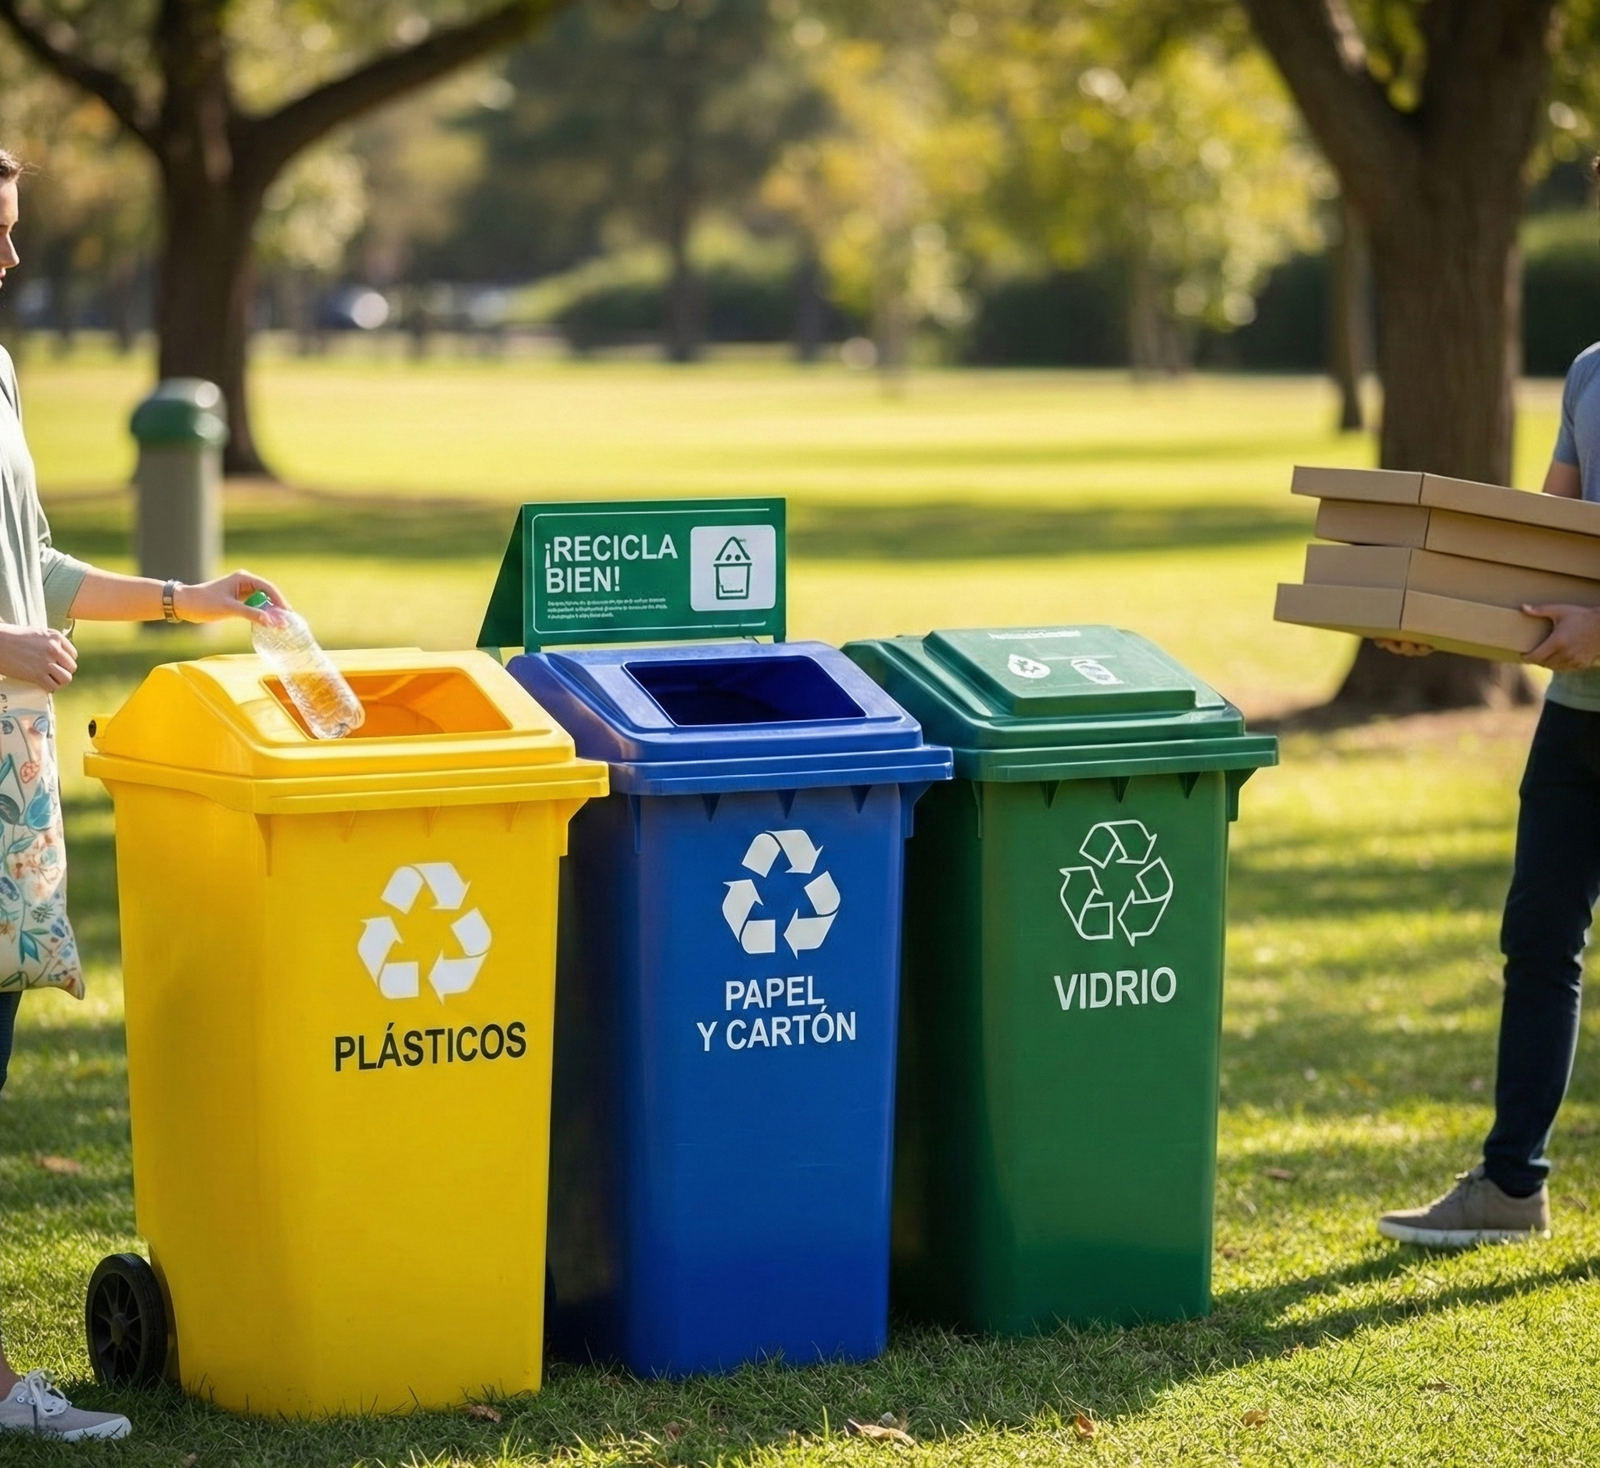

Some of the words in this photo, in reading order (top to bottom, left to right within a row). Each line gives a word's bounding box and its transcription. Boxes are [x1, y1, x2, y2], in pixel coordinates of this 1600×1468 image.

[544, 534, 679, 569] ¡RECICLA
[545, 565, 621, 594] BIEN!
[725, 975, 825, 1011] PAPEL
[1053, 966, 1177, 1011] VIDRIO
[334, 1021, 527, 1072] PLÁSTICOS
[696, 1021, 718, 1052] Y
[726, 1005, 857, 1050] CARTÓN
